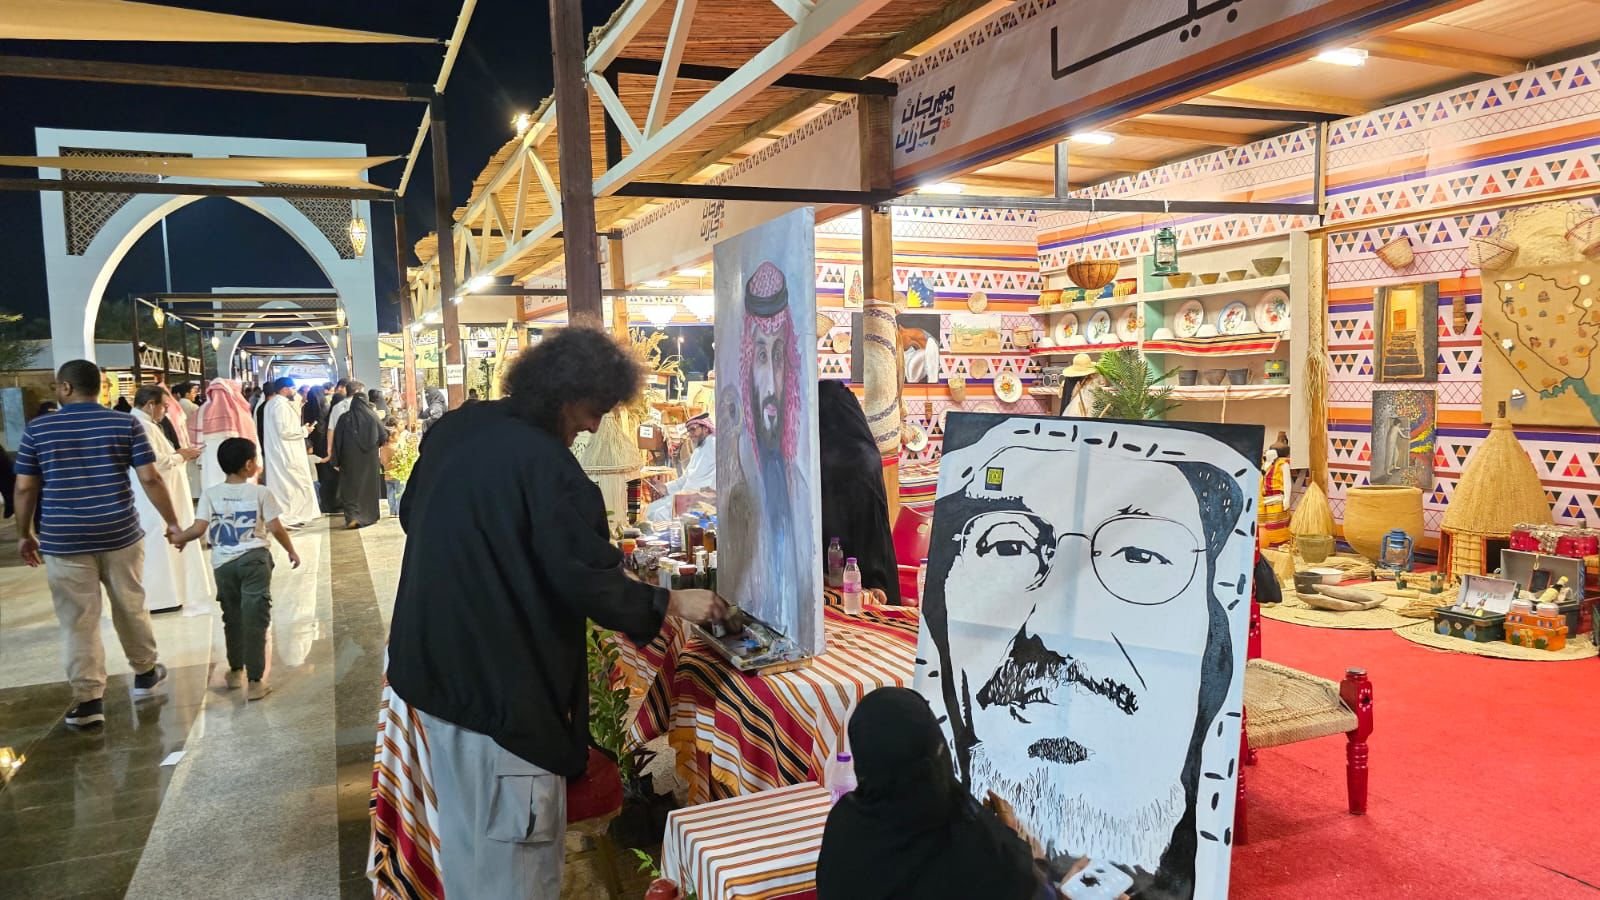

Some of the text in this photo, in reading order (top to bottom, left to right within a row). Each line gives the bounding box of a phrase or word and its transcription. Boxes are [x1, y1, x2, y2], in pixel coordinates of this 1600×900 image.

[901, 85, 956, 124] مهرجان
[944, 103, 955, 116] 20
[895, 116, 942, 153] جازان
